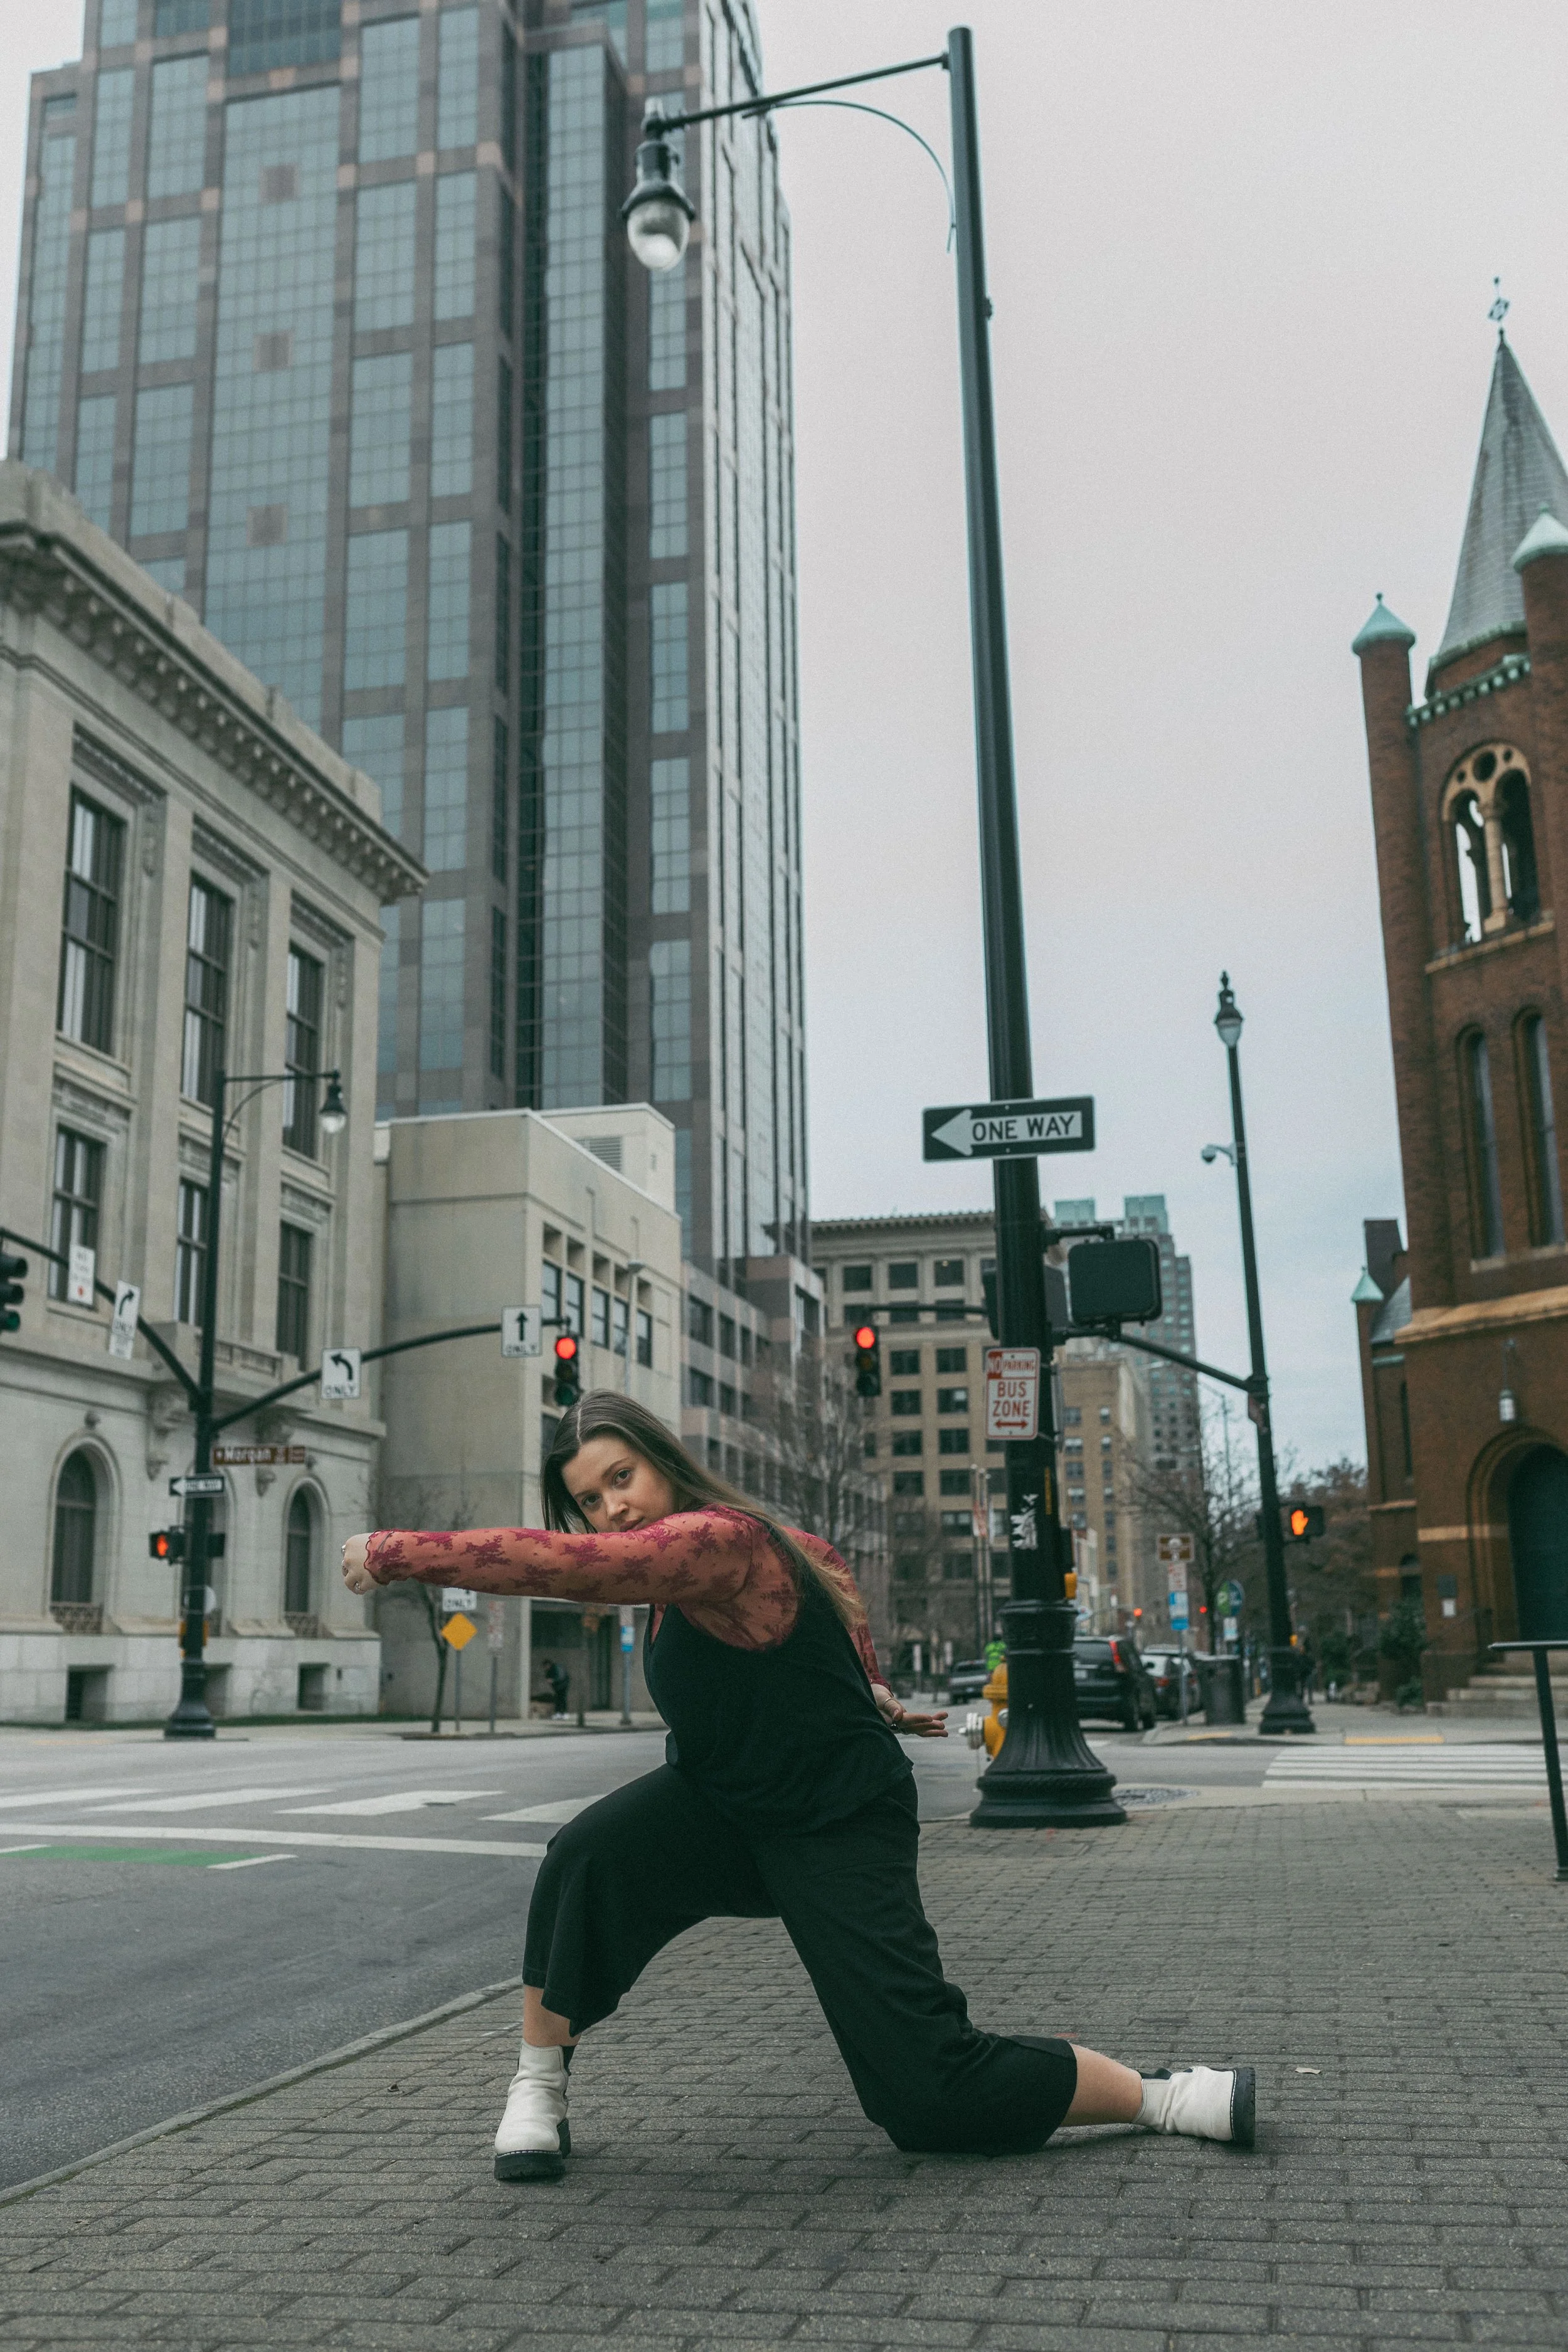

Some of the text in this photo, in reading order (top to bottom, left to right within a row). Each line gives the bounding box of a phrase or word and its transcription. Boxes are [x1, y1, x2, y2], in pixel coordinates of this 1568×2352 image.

[973, 1115, 1074, 1141] ONE WAY
[506, 1343, 538, 1355] ONLY
[987, 1357, 1034, 1373] NO PARKING
[325, 1384, 356, 1397] ONLY
[997, 1381, 1027, 1397] BUS
[993, 1400, 1030, 1417] ZONE
[224, 1447, 272, 1464] Morgan
[445, 1599, 472, 1608] ONLY
